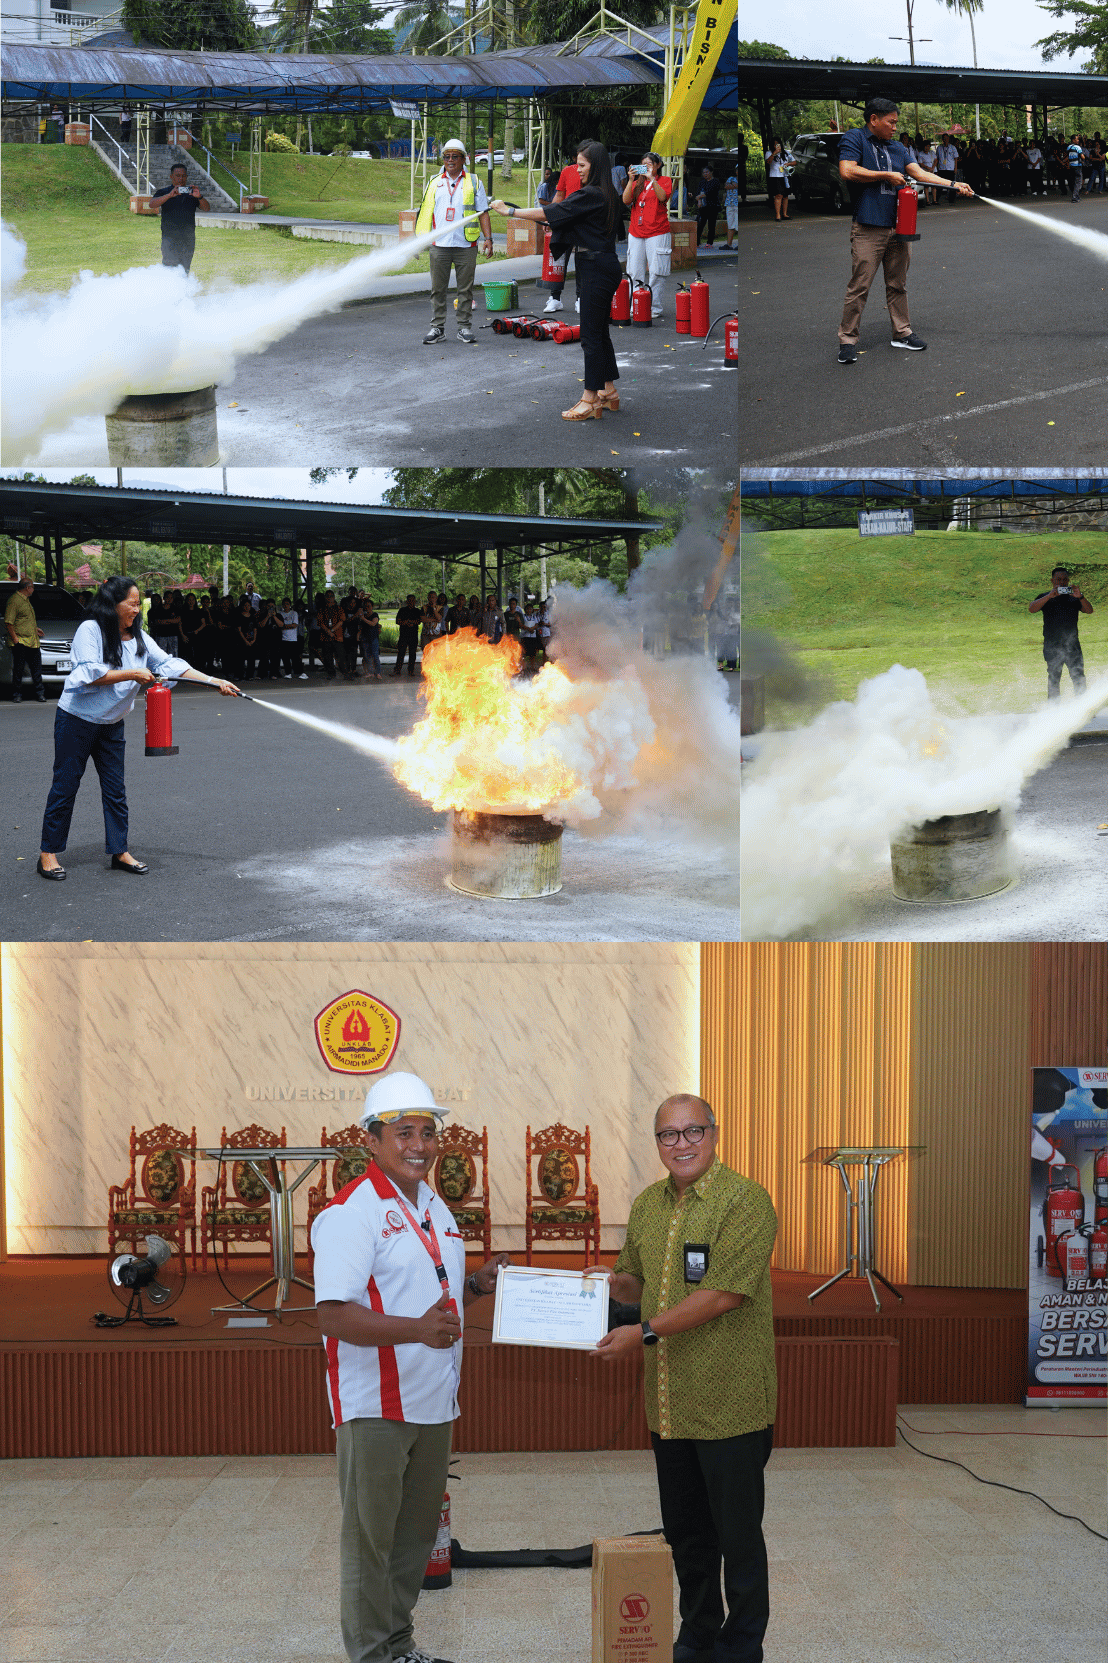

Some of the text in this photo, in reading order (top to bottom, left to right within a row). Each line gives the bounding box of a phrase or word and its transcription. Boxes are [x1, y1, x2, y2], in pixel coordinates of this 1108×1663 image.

[324, 1000, 391, 1035] UNIVERSITAS KLABAT
[326, 1044, 388, 1066] AIRMADIDI MANADO
[245, 1086, 367, 1101] UNIVERSITA
[1051, 1209, 1075, 1217] SERVO
[1040, 1294, 1082, 1308] AMAN
[1085, 1293, 1096, 1306] &
[1041, 1309, 1108, 1331] BERS
